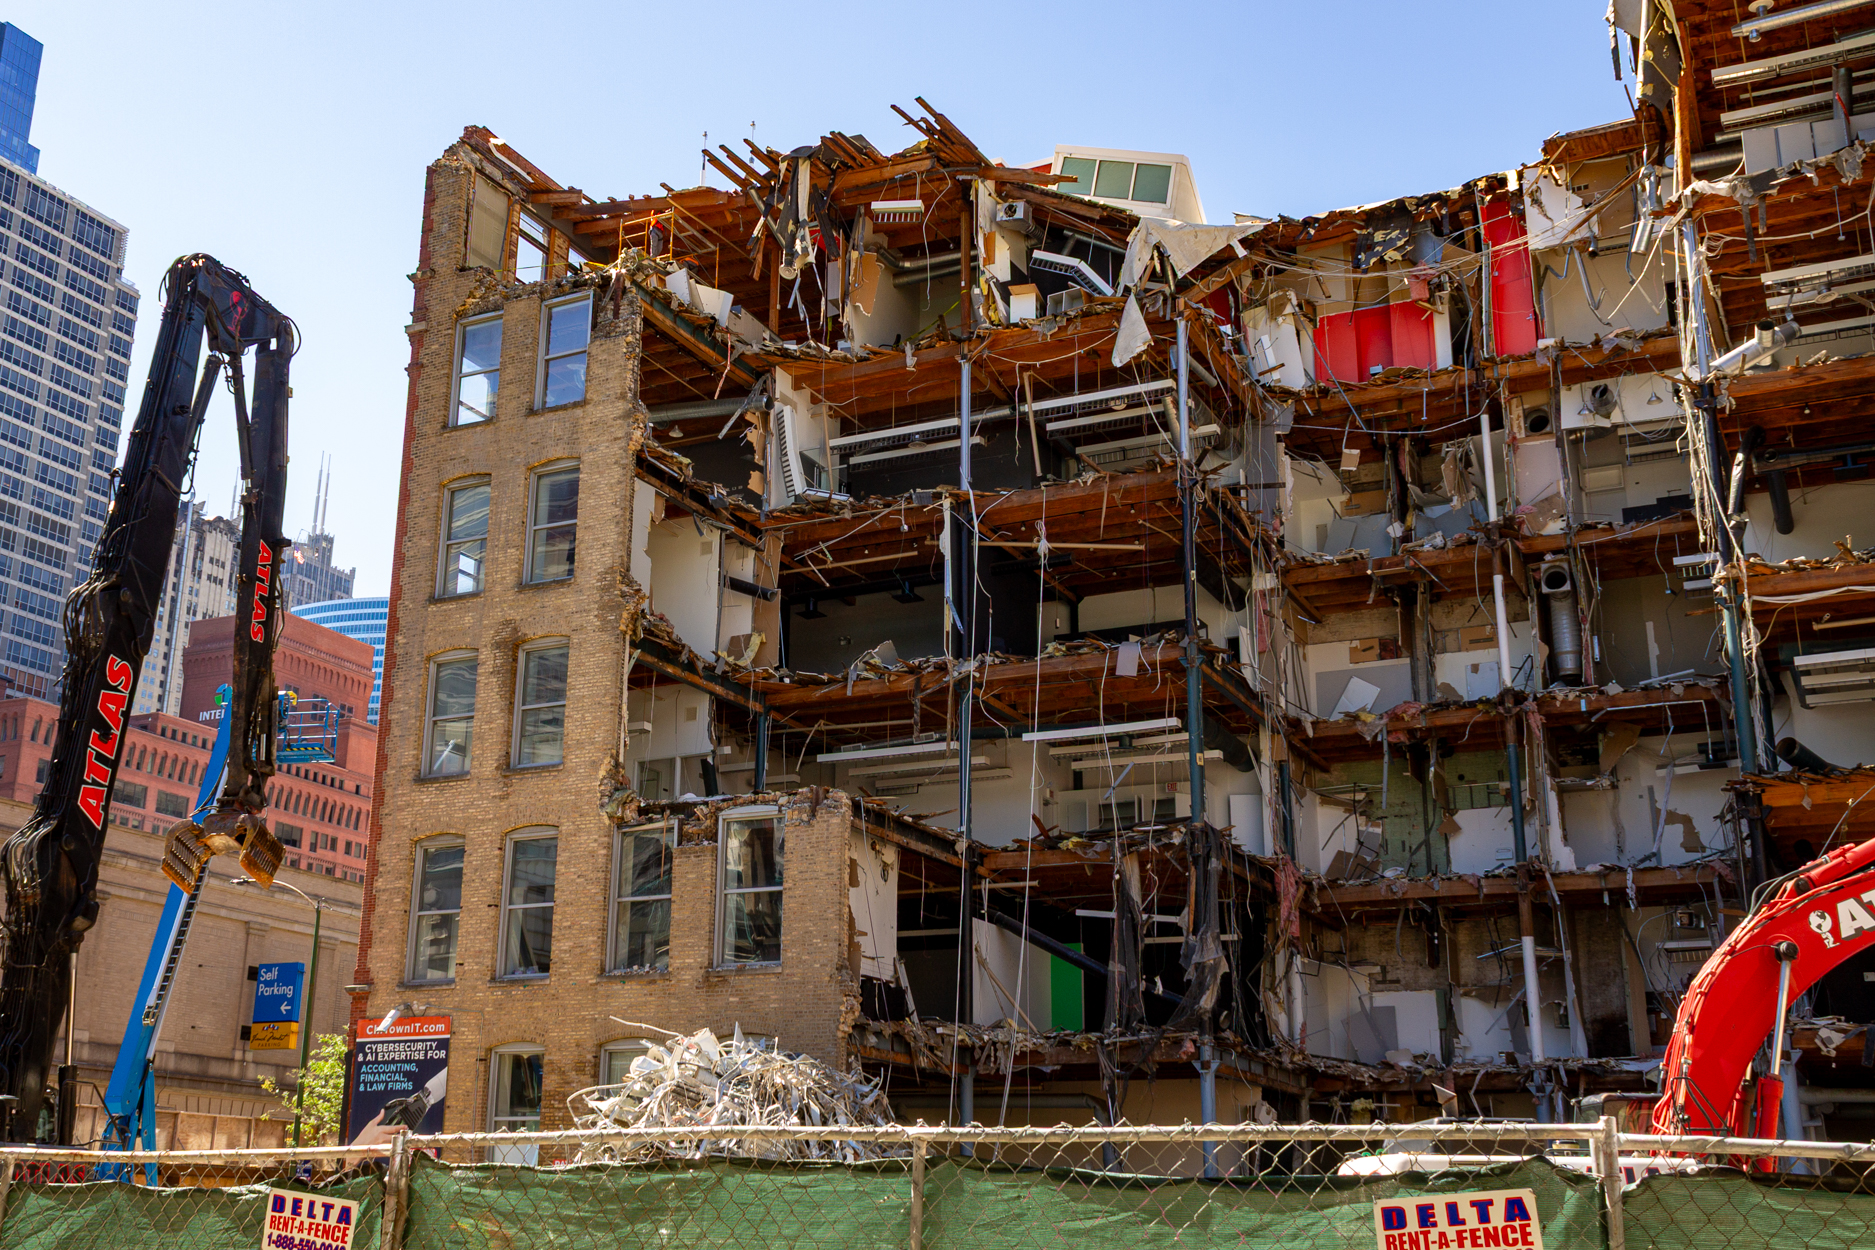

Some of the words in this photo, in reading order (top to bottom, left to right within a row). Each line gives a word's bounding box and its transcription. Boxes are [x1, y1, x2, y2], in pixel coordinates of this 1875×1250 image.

[250, 539, 273, 643] ATLAS
[77, 653, 134, 831] ATLAS
[260, 967, 279, 981] Self
[258, 982, 294, 998] Parking
[365, 1041, 437, 1053] CYBERSECURITY
[357, 1053, 364, 1062] &
[366, 1052, 375, 1061] AI
[378, 1050, 425, 1061] EXPERTISE
[427, 1050, 446, 1059] FOR
[360, 1063, 419, 1073] ACCOUNTING,
[360, 1073, 408, 1082] FINANCIAL,
[359, 1083, 365, 1091] &
[366, 1083, 386, 1091] LAW
[387, 1082, 413, 1090] FIRMS
[271, 1194, 352, 1226] DELTA
[1381, 1197, 1532, 1231] DELTA
[269, 1215, 350, 1245] RENT-A-FENCE
[1385, 1223, 1535, 1250] RENT-A-FENCE
